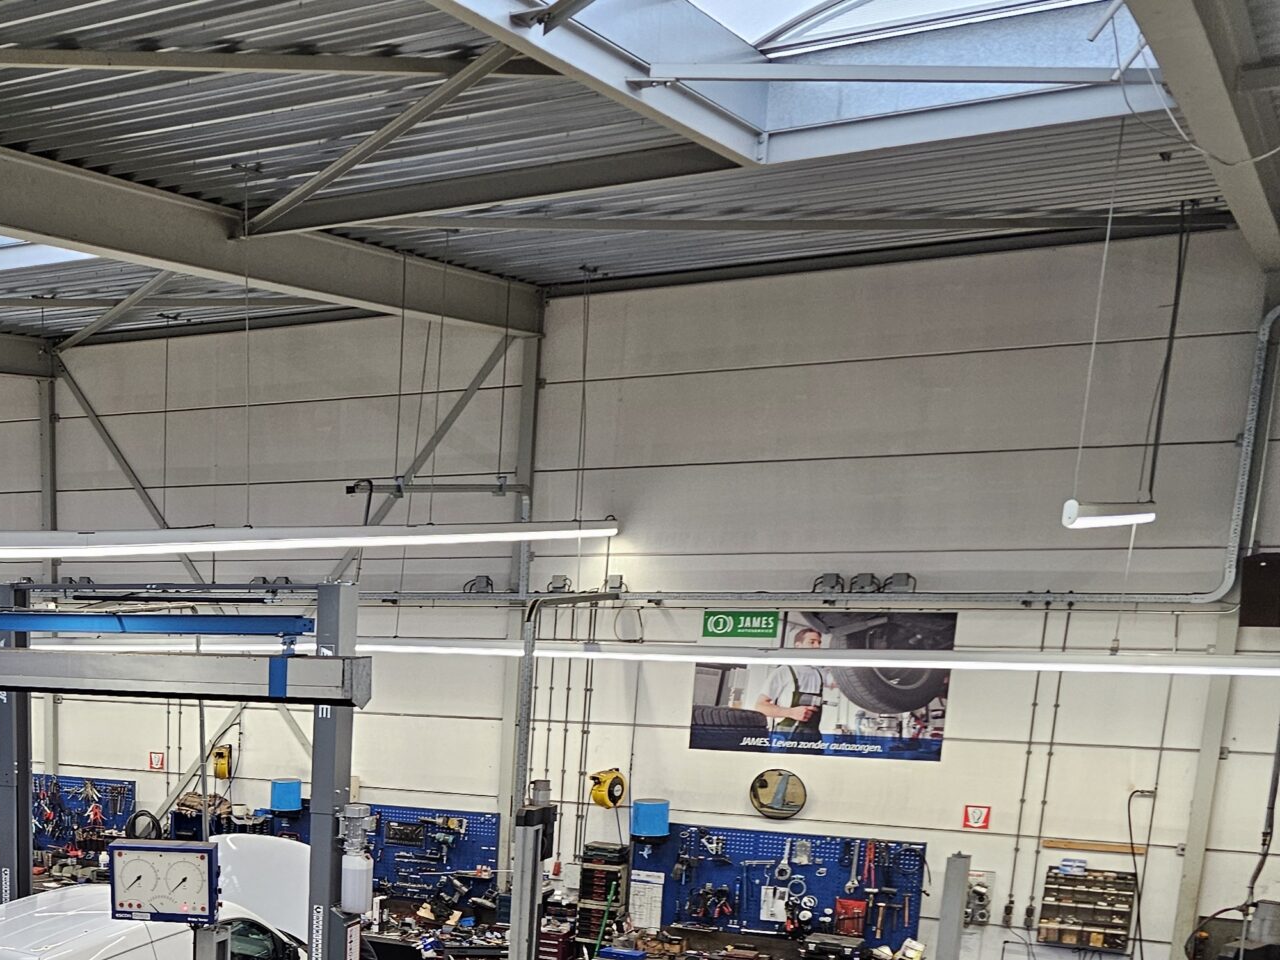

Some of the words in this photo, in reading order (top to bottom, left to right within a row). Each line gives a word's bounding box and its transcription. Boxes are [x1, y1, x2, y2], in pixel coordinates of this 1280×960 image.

[737, 616, 774, 628] JAMES
[739, 736, 771, 747] JAMES.
[771, 738, 798, 748] Leven
[798, 739, 829, 750] zonder
[829, 742, 883, 754] autozorgen.
